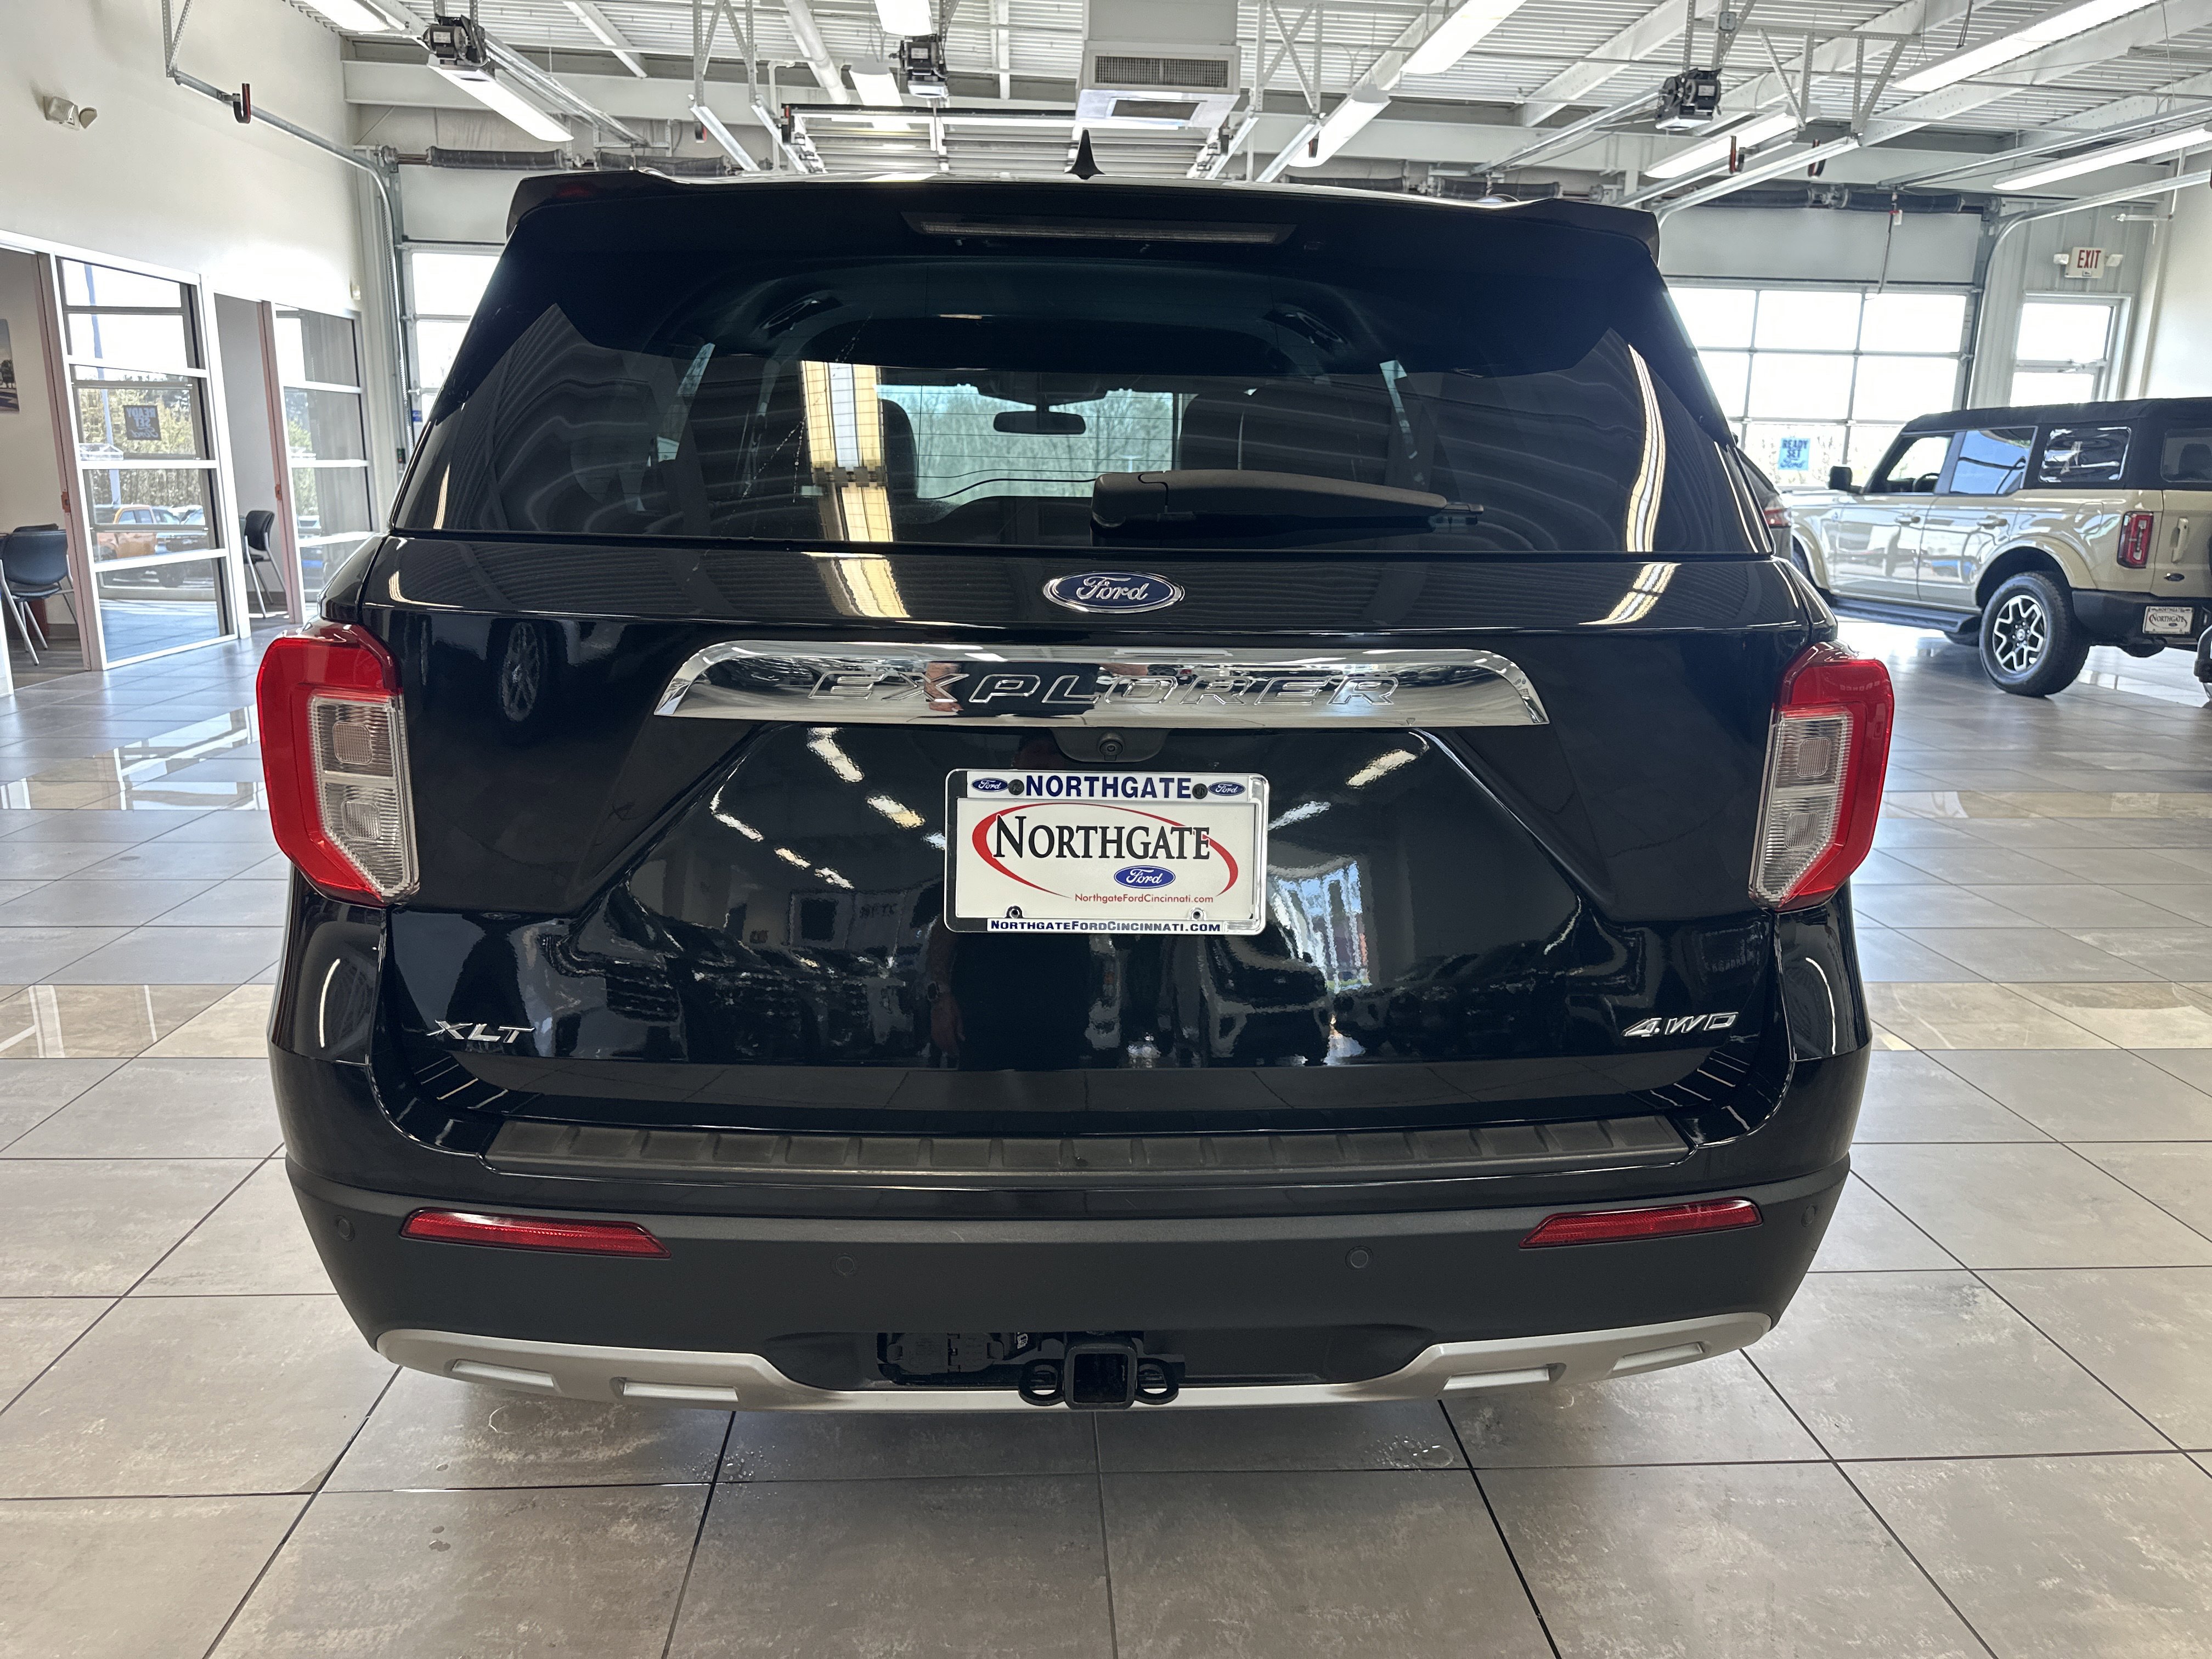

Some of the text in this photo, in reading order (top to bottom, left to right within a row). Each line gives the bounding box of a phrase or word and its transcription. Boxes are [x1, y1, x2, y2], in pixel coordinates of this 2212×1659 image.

[2077, 250, 2101, 268] EXIT
[1782, 439, 1808, 449] READY
[1786, 448, 1801, 458] SET
[1076, 576, 1150, 600] Ford
[808, 670, 1395, 706] EXPLORER
[978, 775, 1238, 799] Ford NORTHGATE Ford
[1126, 868, 1163, 884] Ford
[1075, 893, 1214, 904] NorthgateFordCincinnati.com
[426, 1019, 535, 1043] XLT
[1622, 1012, 1739, 1037] 4WD
